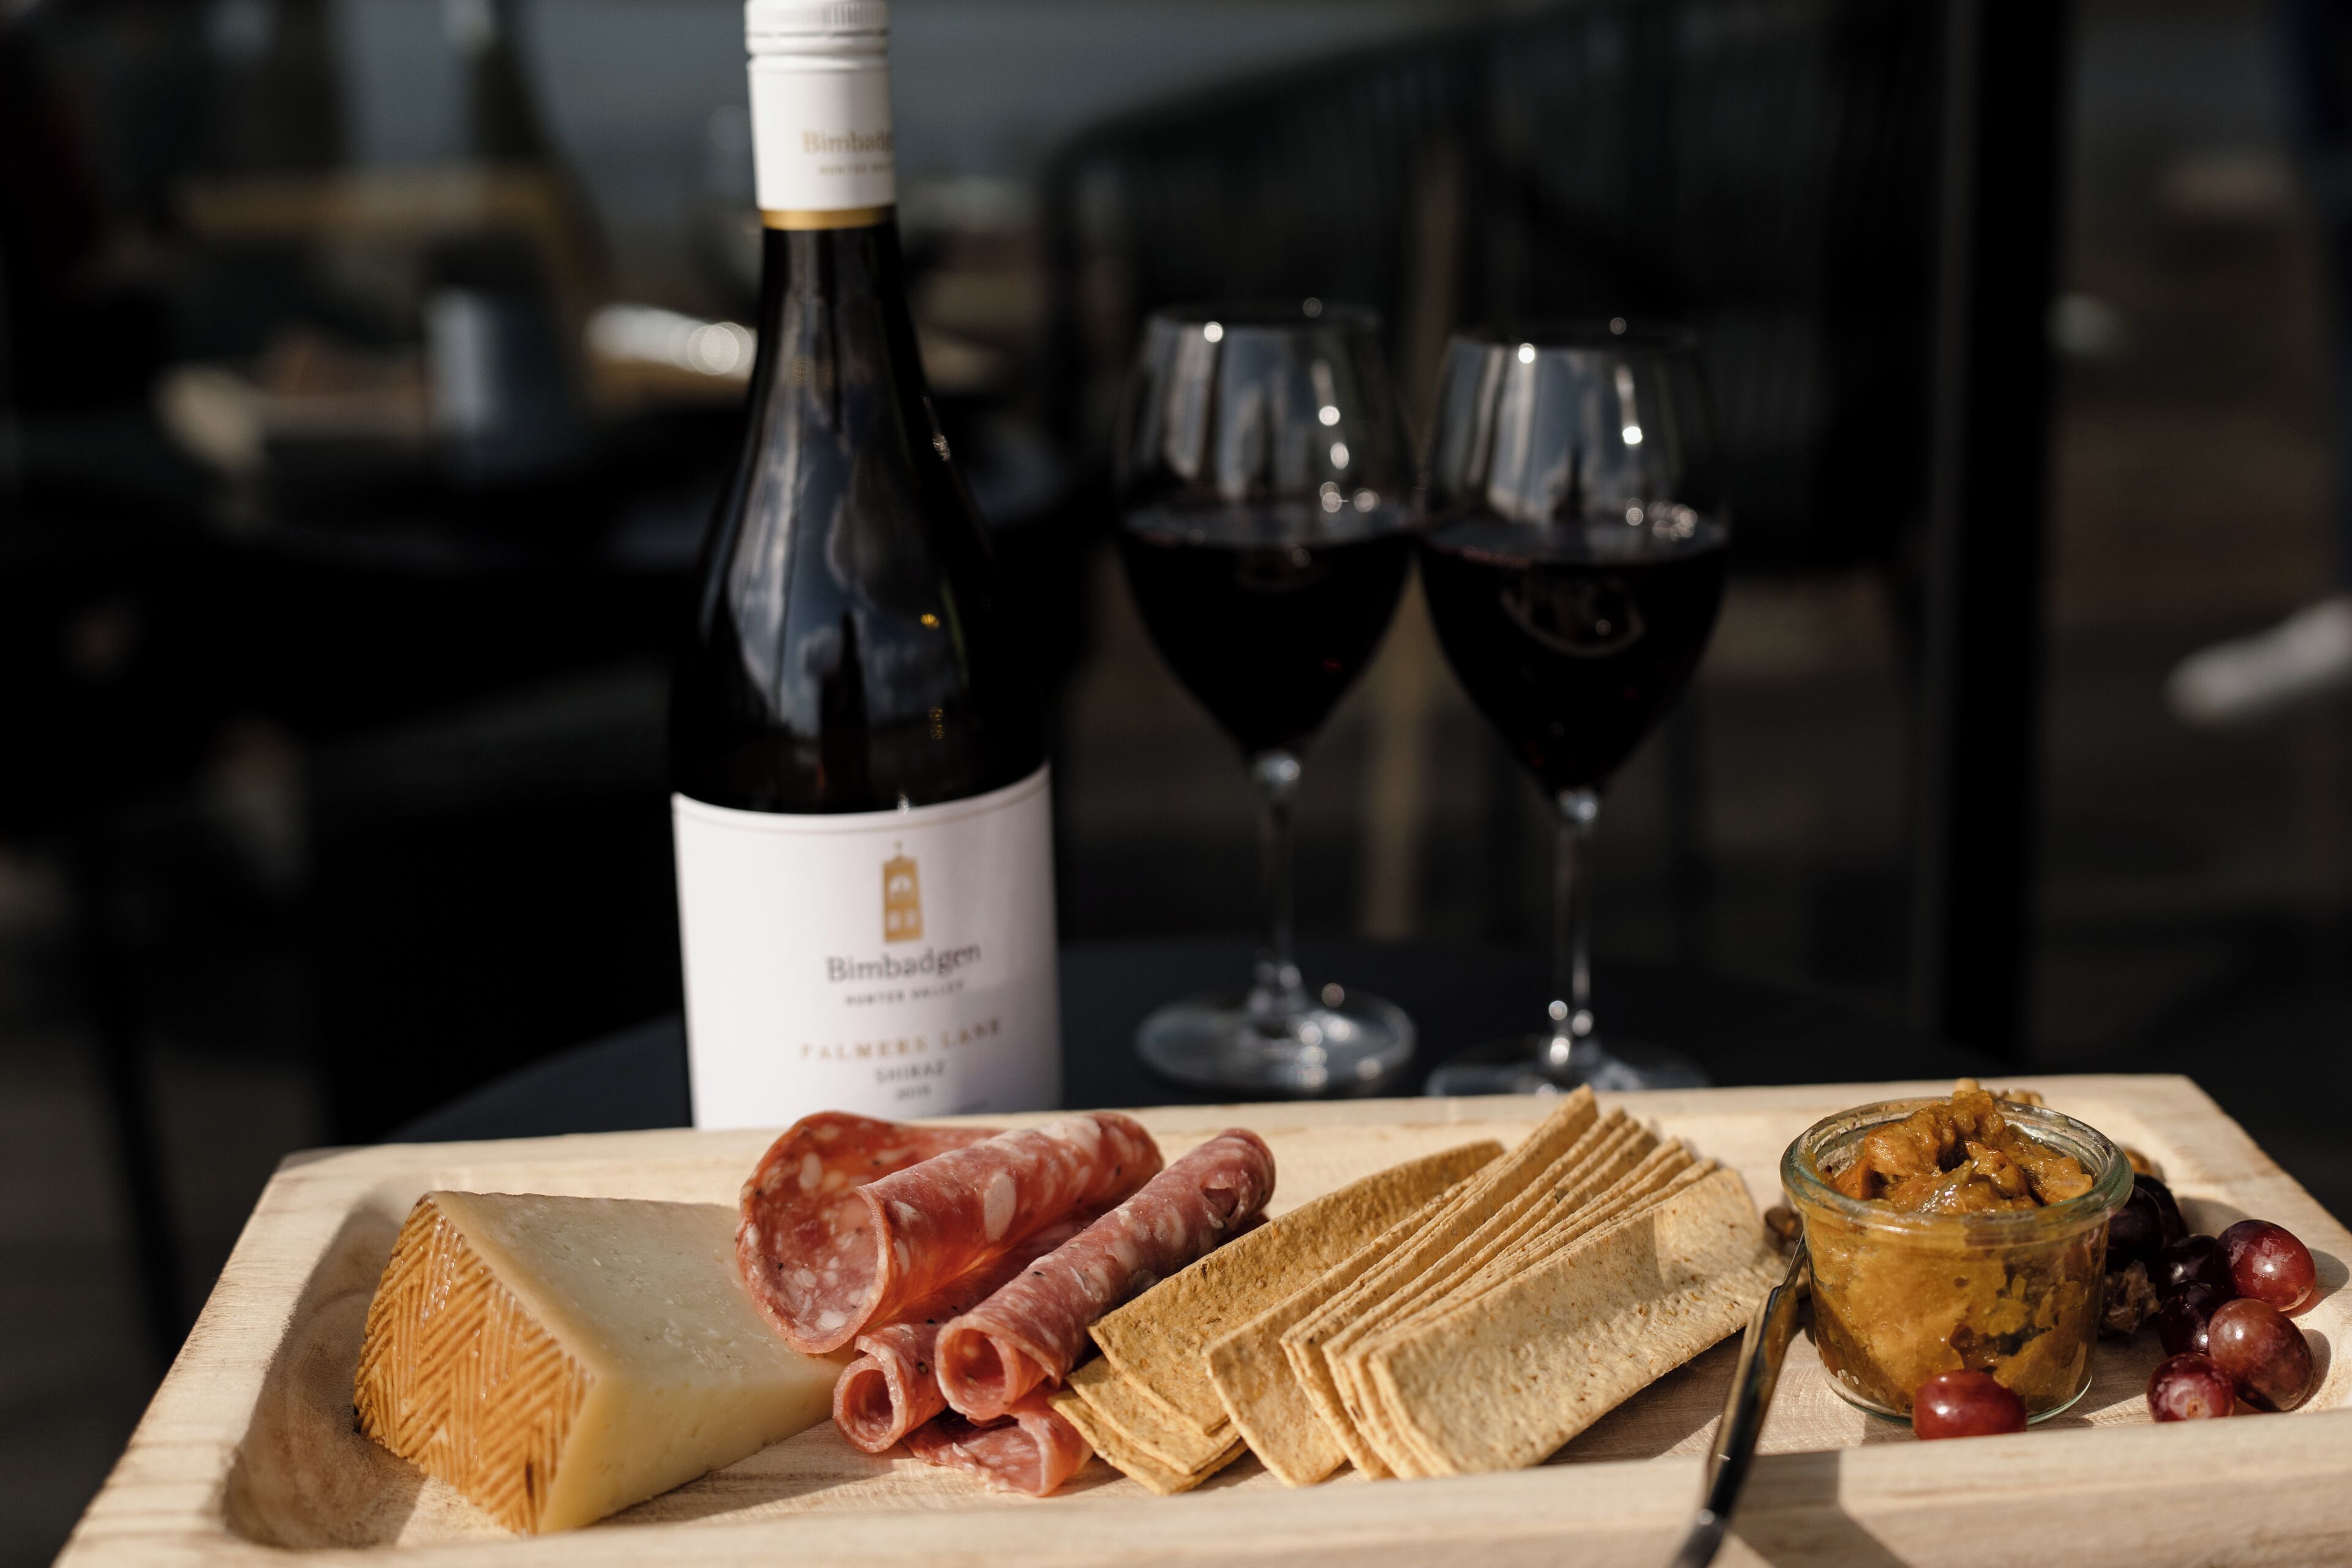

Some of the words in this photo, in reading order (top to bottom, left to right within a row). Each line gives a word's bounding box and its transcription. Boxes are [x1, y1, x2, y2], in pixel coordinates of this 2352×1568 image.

[826, 944, 981, 981] Bimbadgen
[802, 1035, 928, 1060] PALMERS
[875, 1061, 946, 1084] SHIRAZ
